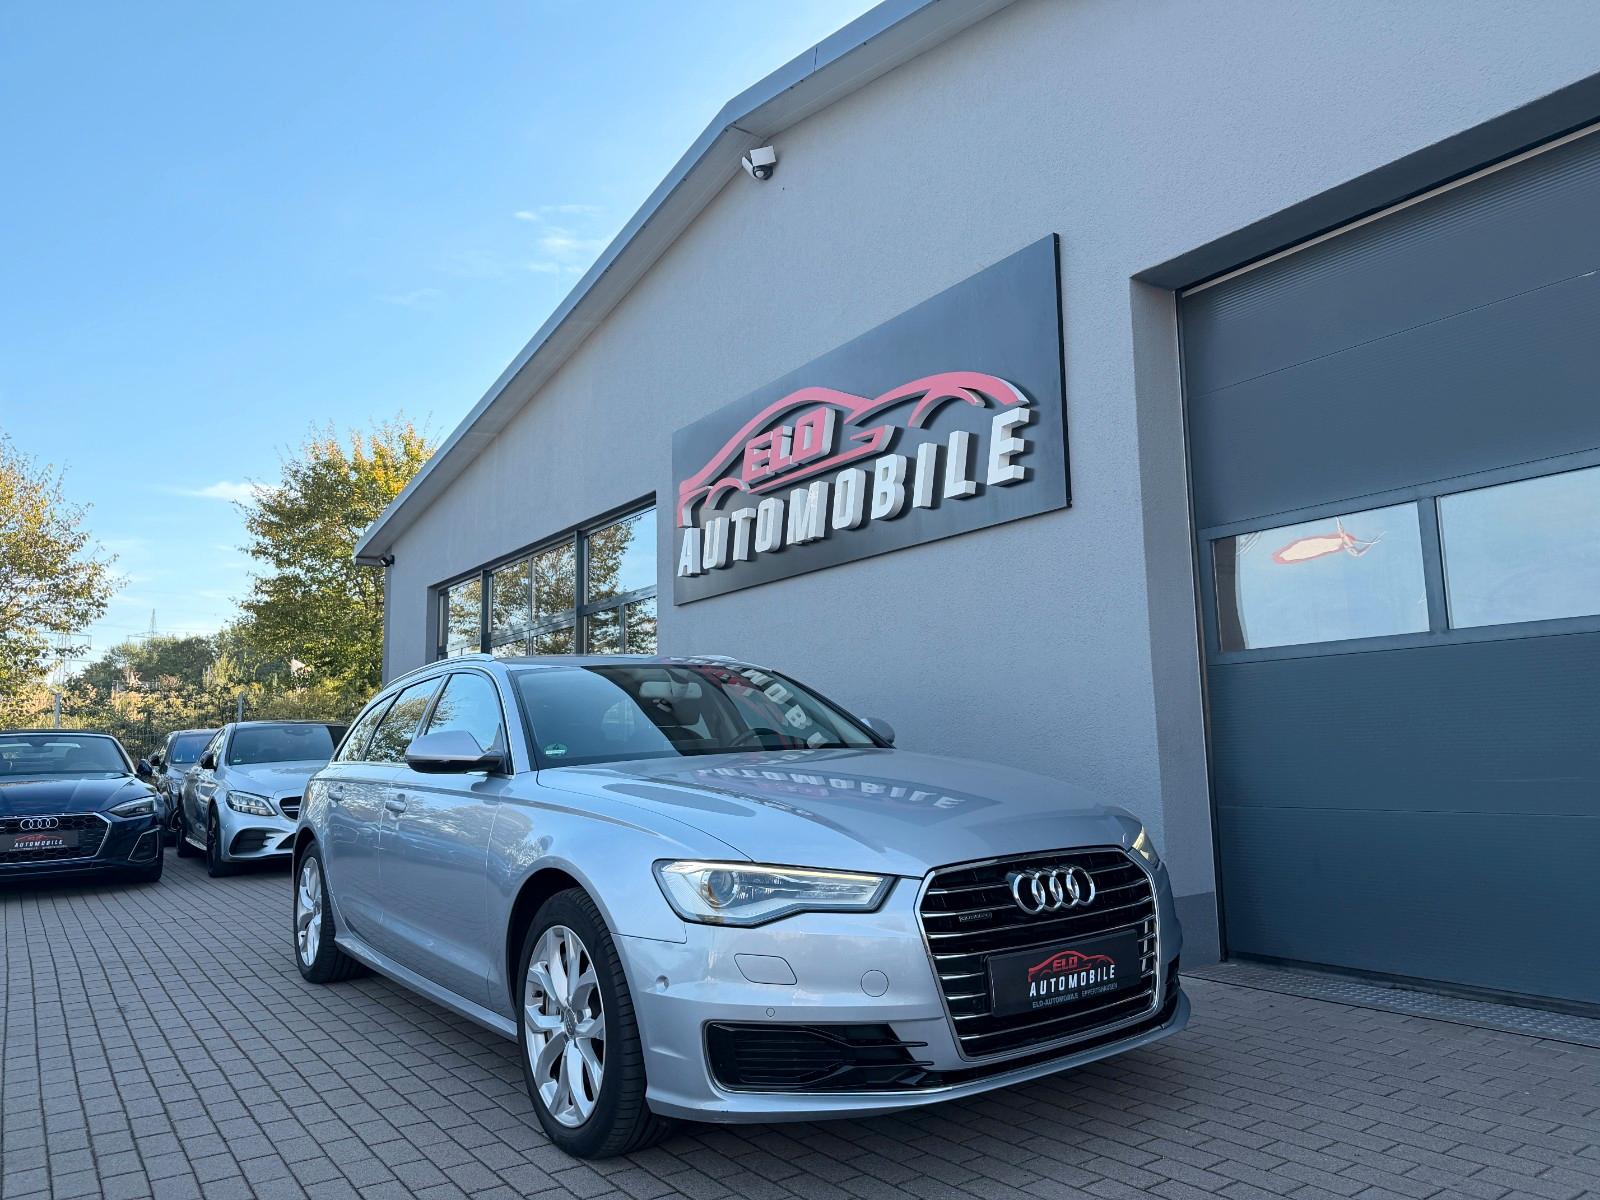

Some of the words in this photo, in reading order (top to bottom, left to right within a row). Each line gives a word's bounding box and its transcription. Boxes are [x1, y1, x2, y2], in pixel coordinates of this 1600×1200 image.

[741, 407, 836, 483] ELO
[677, 406, 1031, 577] AUTOMOBILE
[14, 839, 63, 848] AUTOMOBILE
[1029, 964, 1116, 997] AUTOMOBILE
[1053, 956, 1078, 974] ELO
